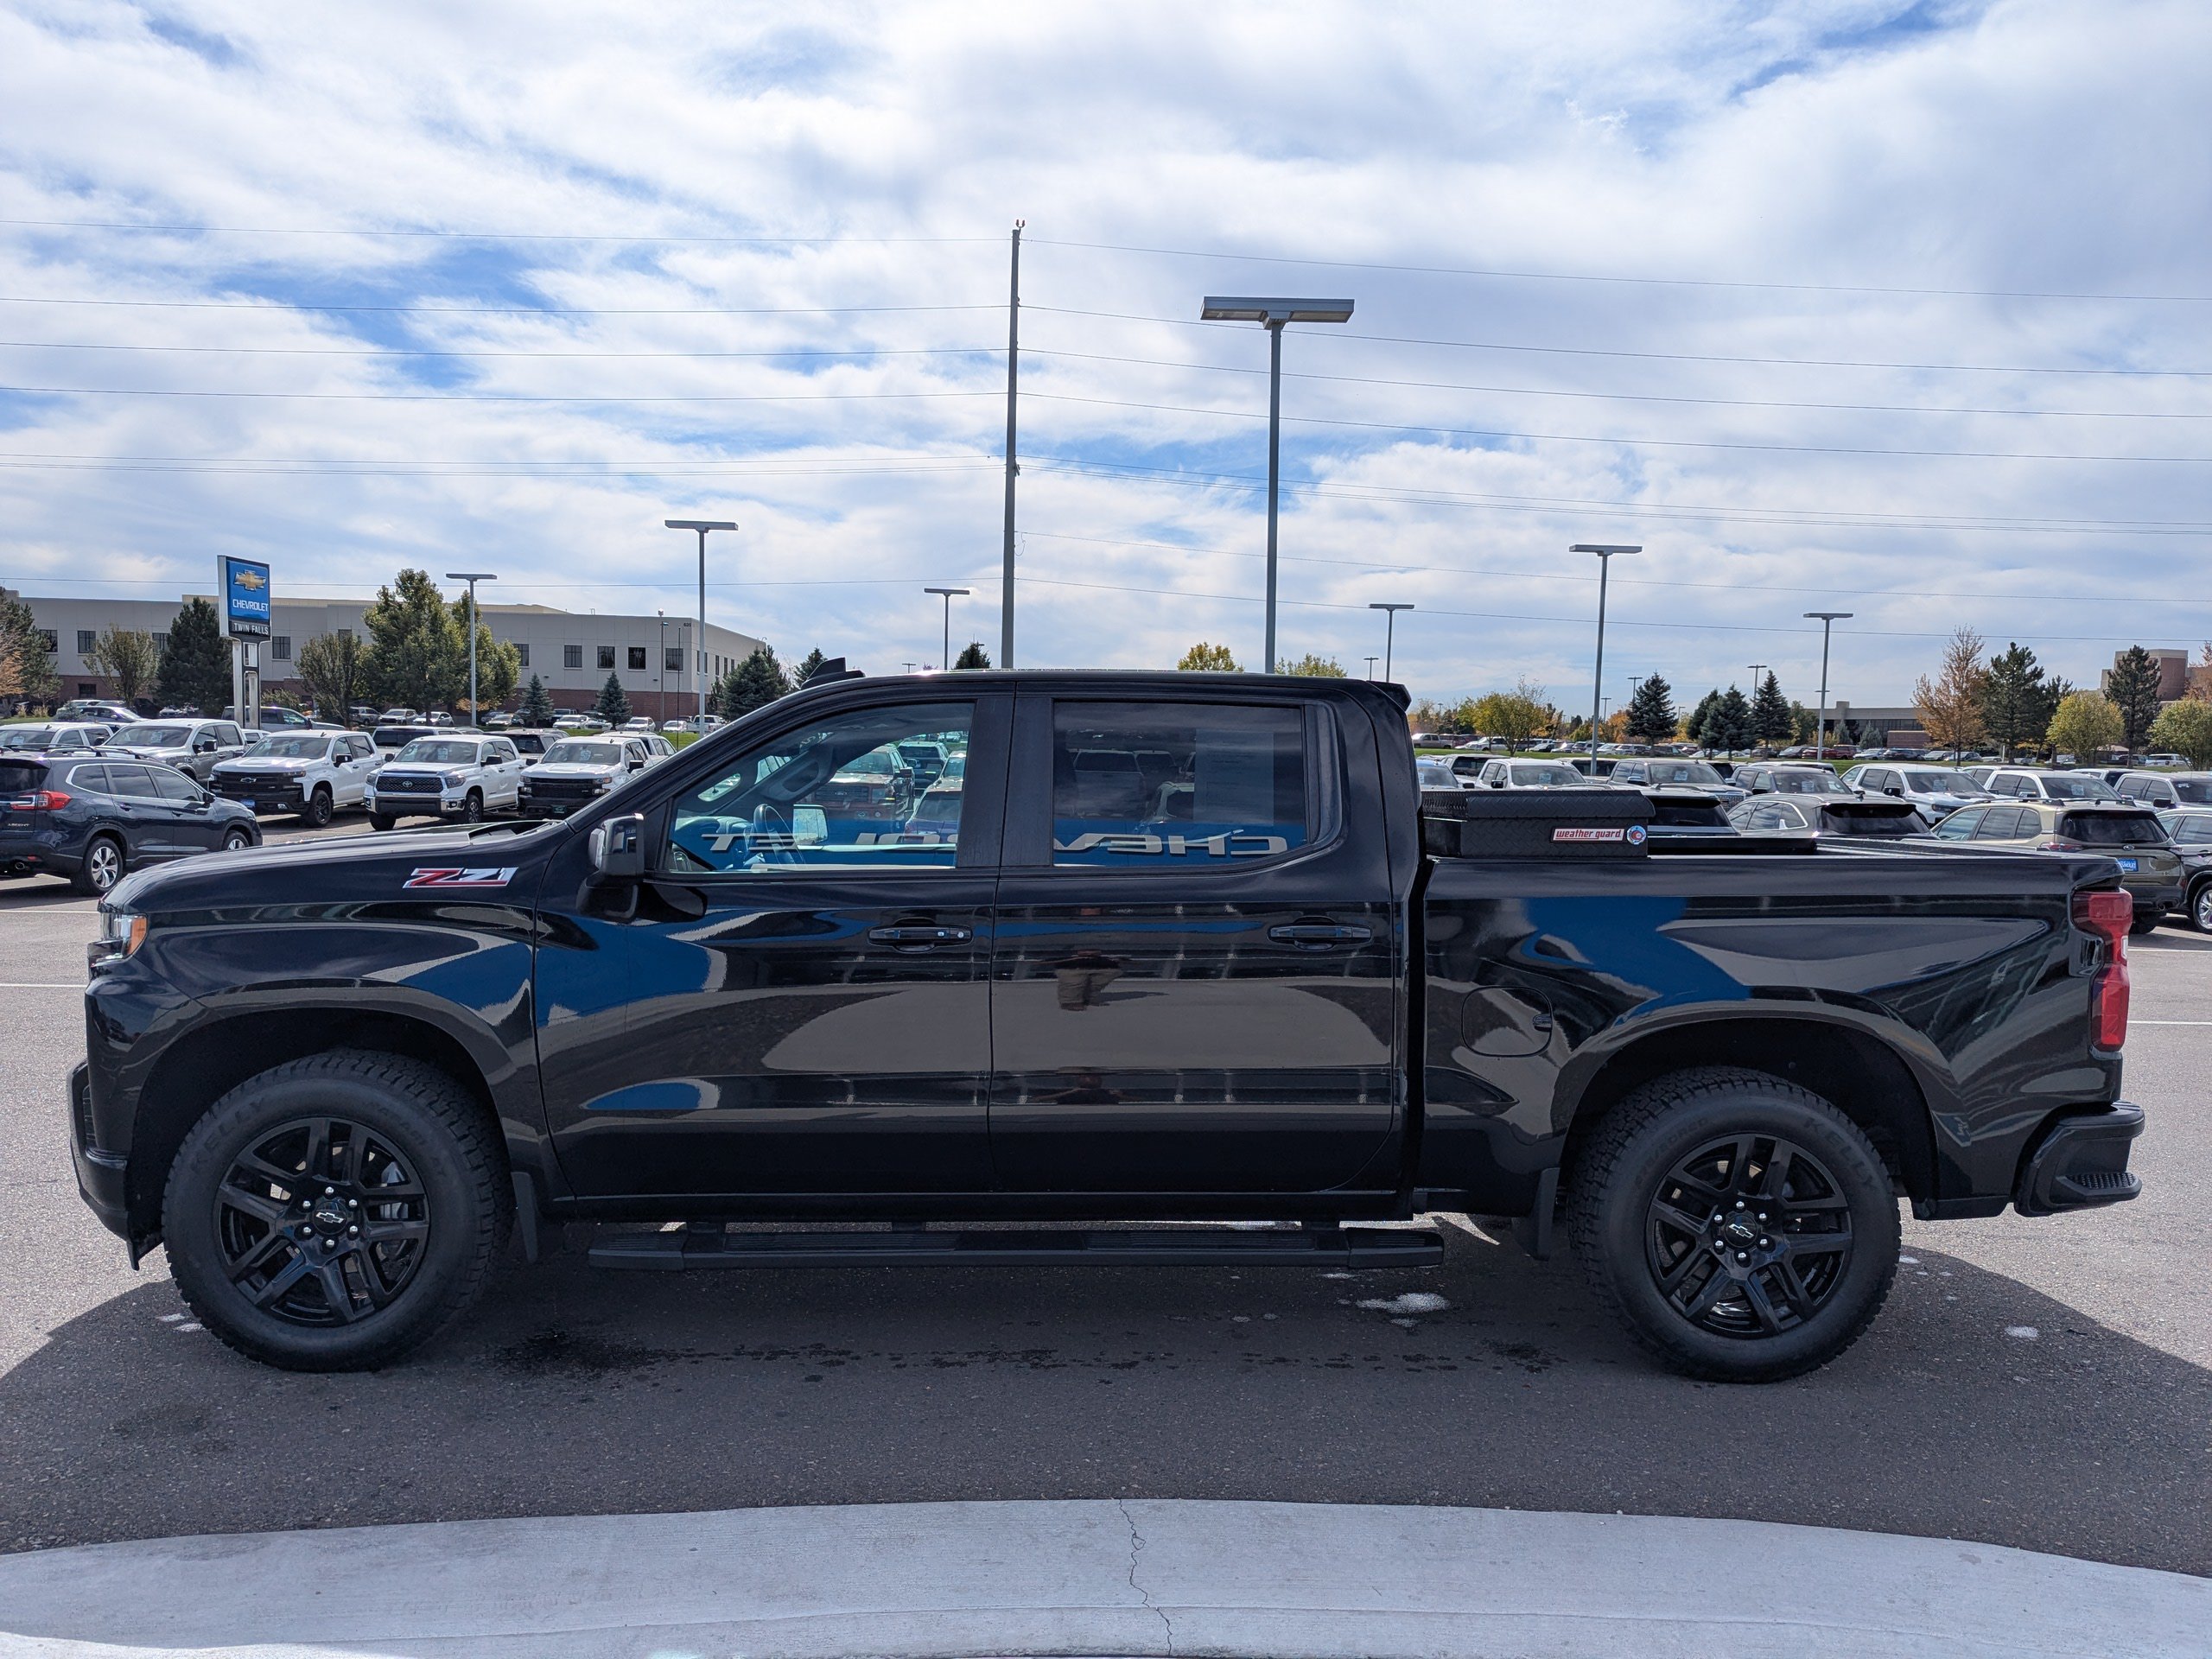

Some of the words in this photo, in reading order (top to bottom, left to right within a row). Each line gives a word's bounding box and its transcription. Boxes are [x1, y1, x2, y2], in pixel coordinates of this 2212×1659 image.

[232, 599, 269, 612] CHEVROLET
[233, 622, 250, 632] TWIN
[251, 624, 269, 635] FALLS
[1556, 830, 1594, 838] weather
[1595, 830, 1622, 839] guard
[402, 867, 518, 889] Z71
